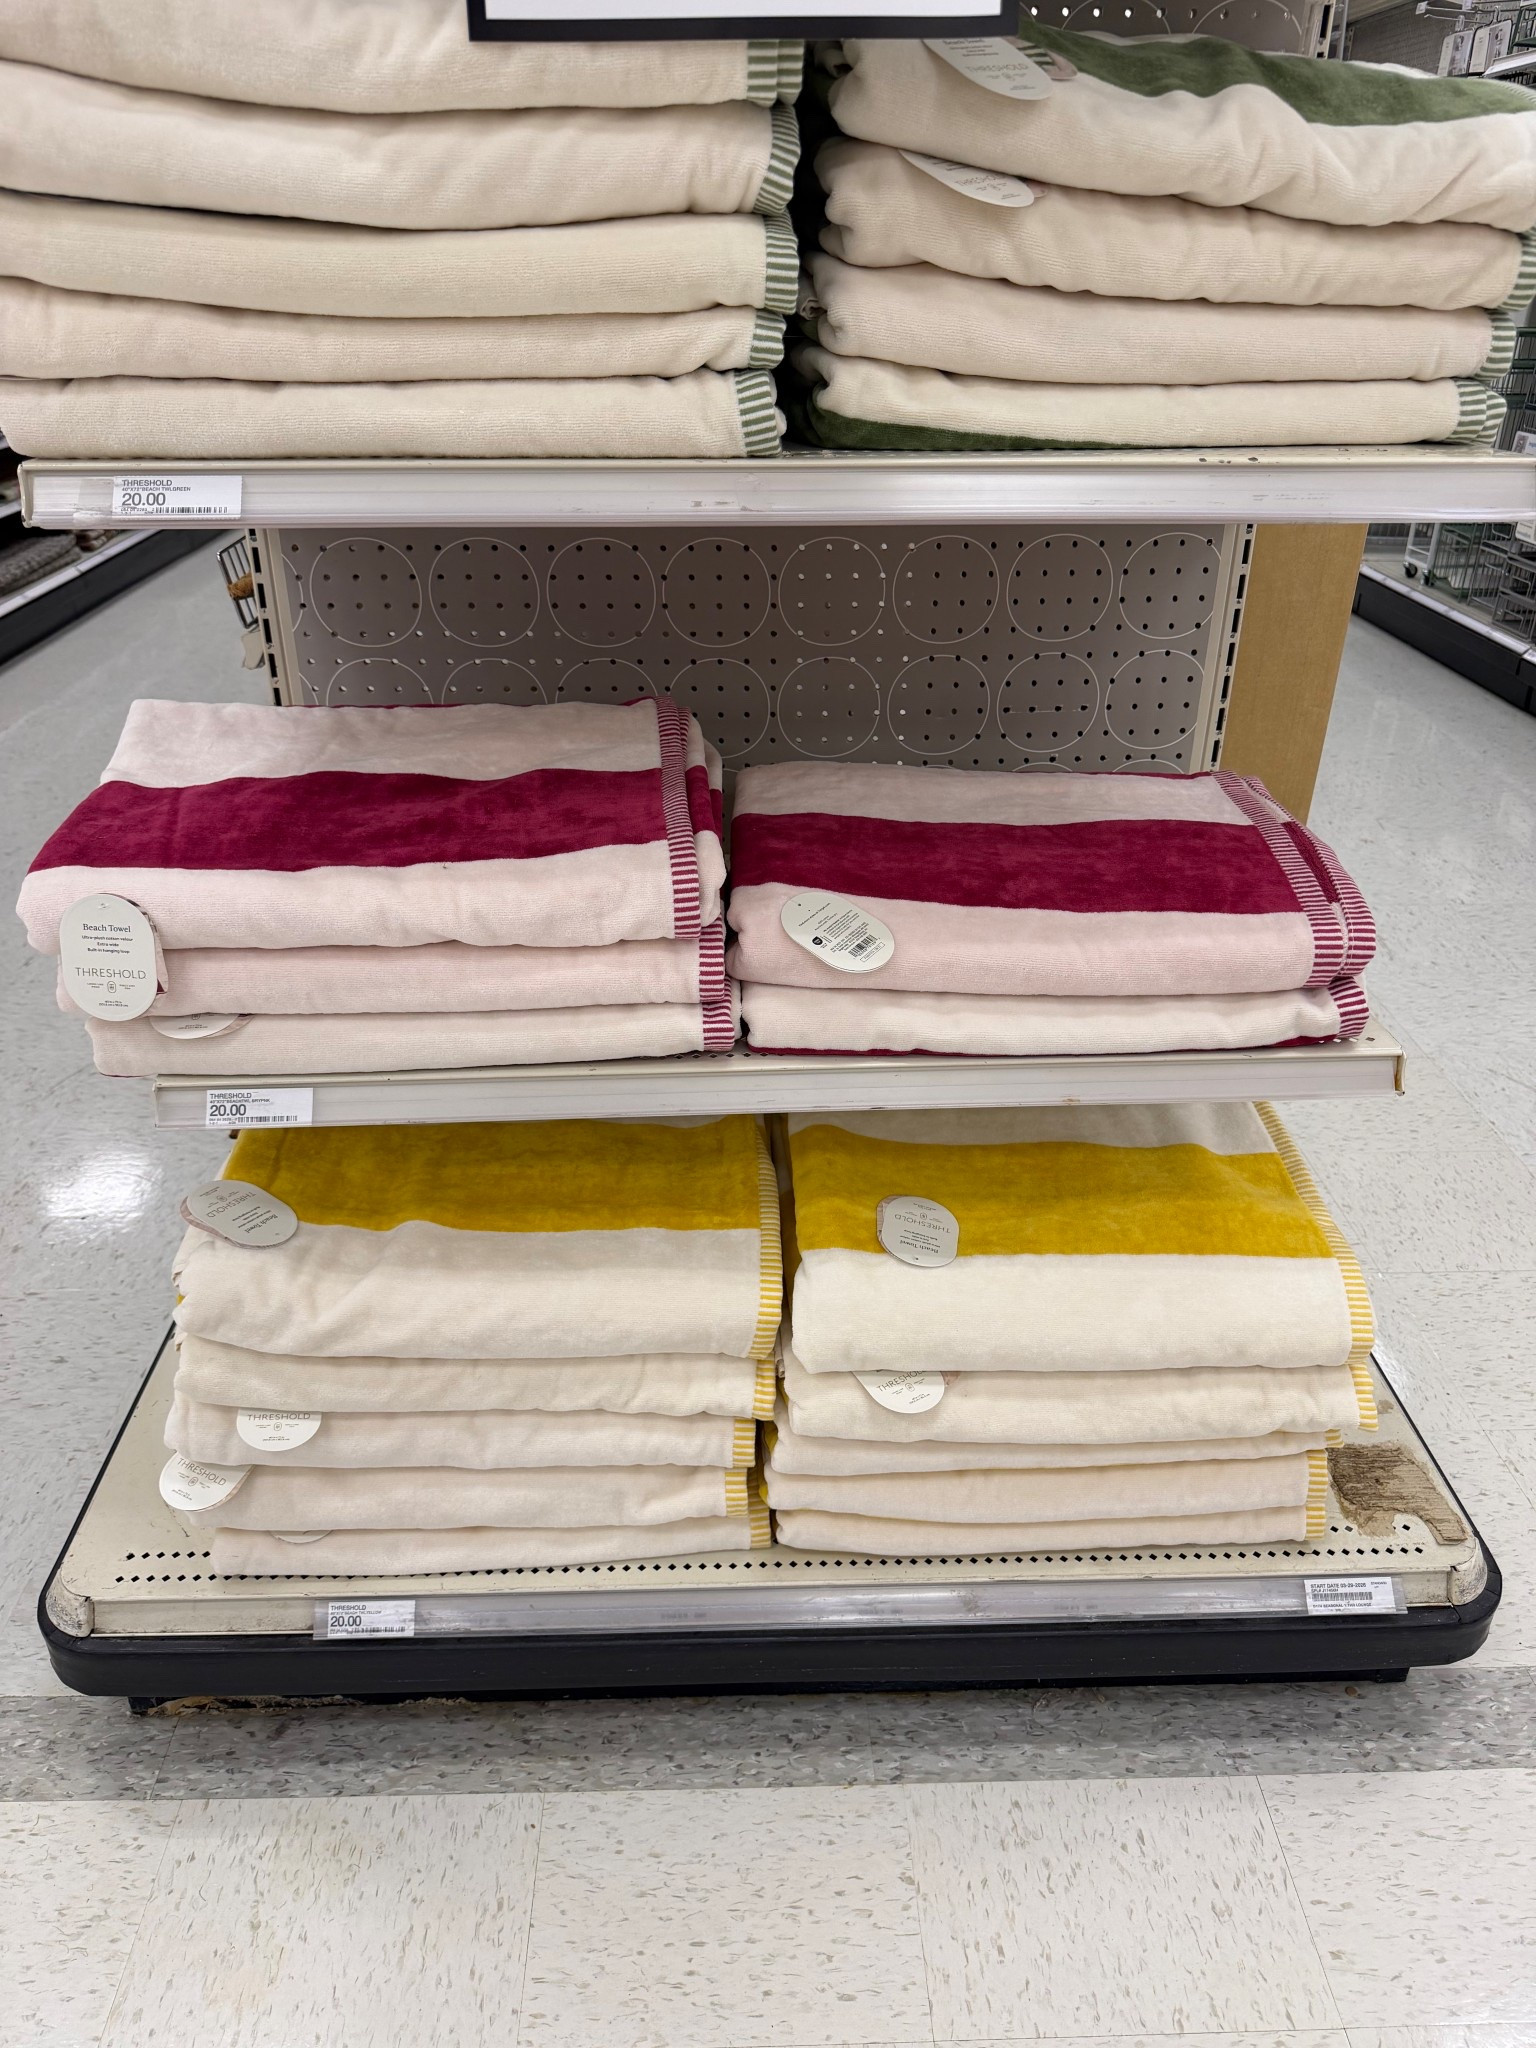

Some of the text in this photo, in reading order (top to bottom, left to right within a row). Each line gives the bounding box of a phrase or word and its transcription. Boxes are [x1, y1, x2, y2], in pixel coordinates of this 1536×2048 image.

[121, 479, 173, 487] THRESHOLD
[121, 492, 166, 506] 20.00
[83, 923, 131, 933] Beach Towel
[75, 967, 147, 979] THRESHOLD
[209, 1092, 252, 1100] THRESHOLD
[209, 1104, 246, 1117] 20.00
[206, 1191, 256, 1218] THRESHOLD
[894, 1213, 951, 1234] THRESHOLD
[919, 1245, 939, 1254] Beach
[247, 1412, 311, 1421] THRESHOLD
[177, 1457, 227, 1486] THRESHOLD
[330, 1615, 362, 1627] 20.00
